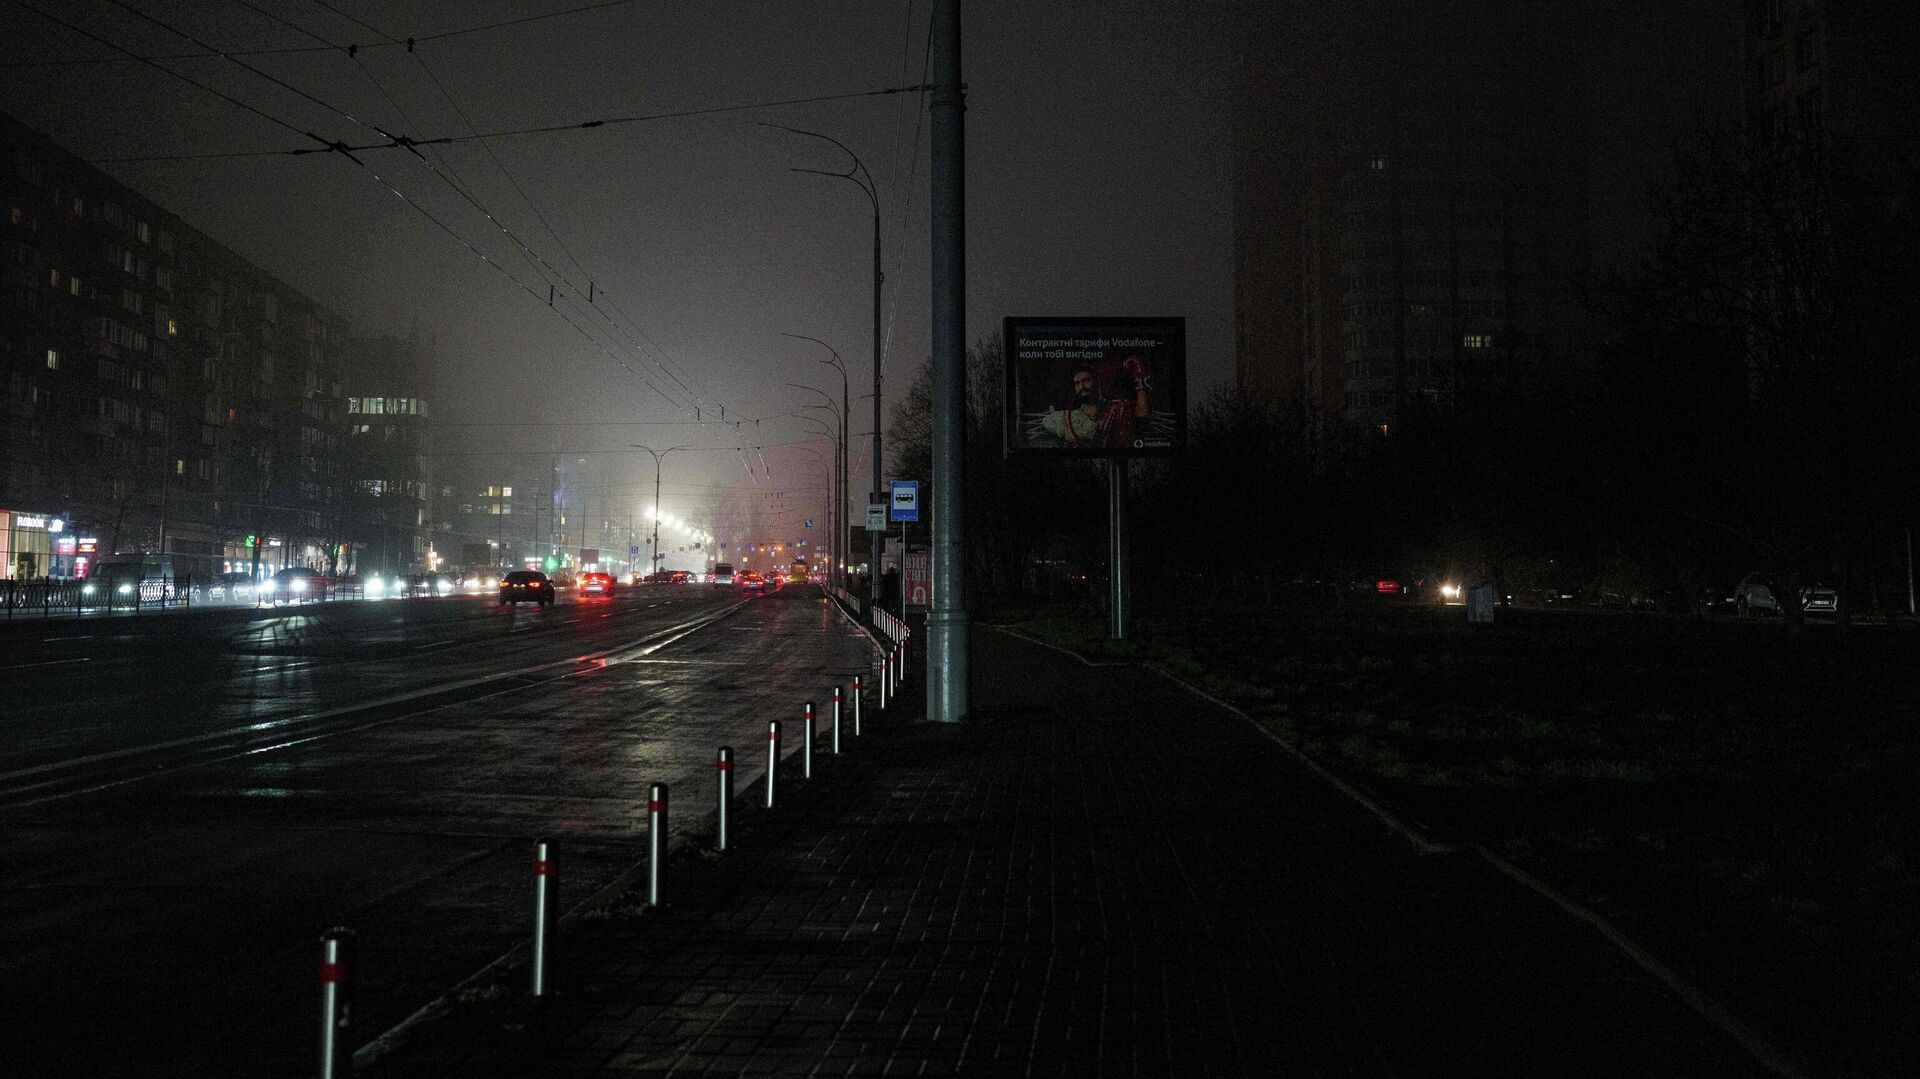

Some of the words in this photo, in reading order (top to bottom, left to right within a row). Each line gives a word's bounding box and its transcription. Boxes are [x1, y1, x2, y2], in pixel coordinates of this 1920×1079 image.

[1019, 338, 1073, 349] Контрактні
[1074, 338, 1110, 349] тарифи
[1019, 351, 1043, 359] коли
[1044, 349, 1064, 359] тобі
[1066, 349, 1103, 360] вигідно
[1144, 439, 1171, 447] vodafone
